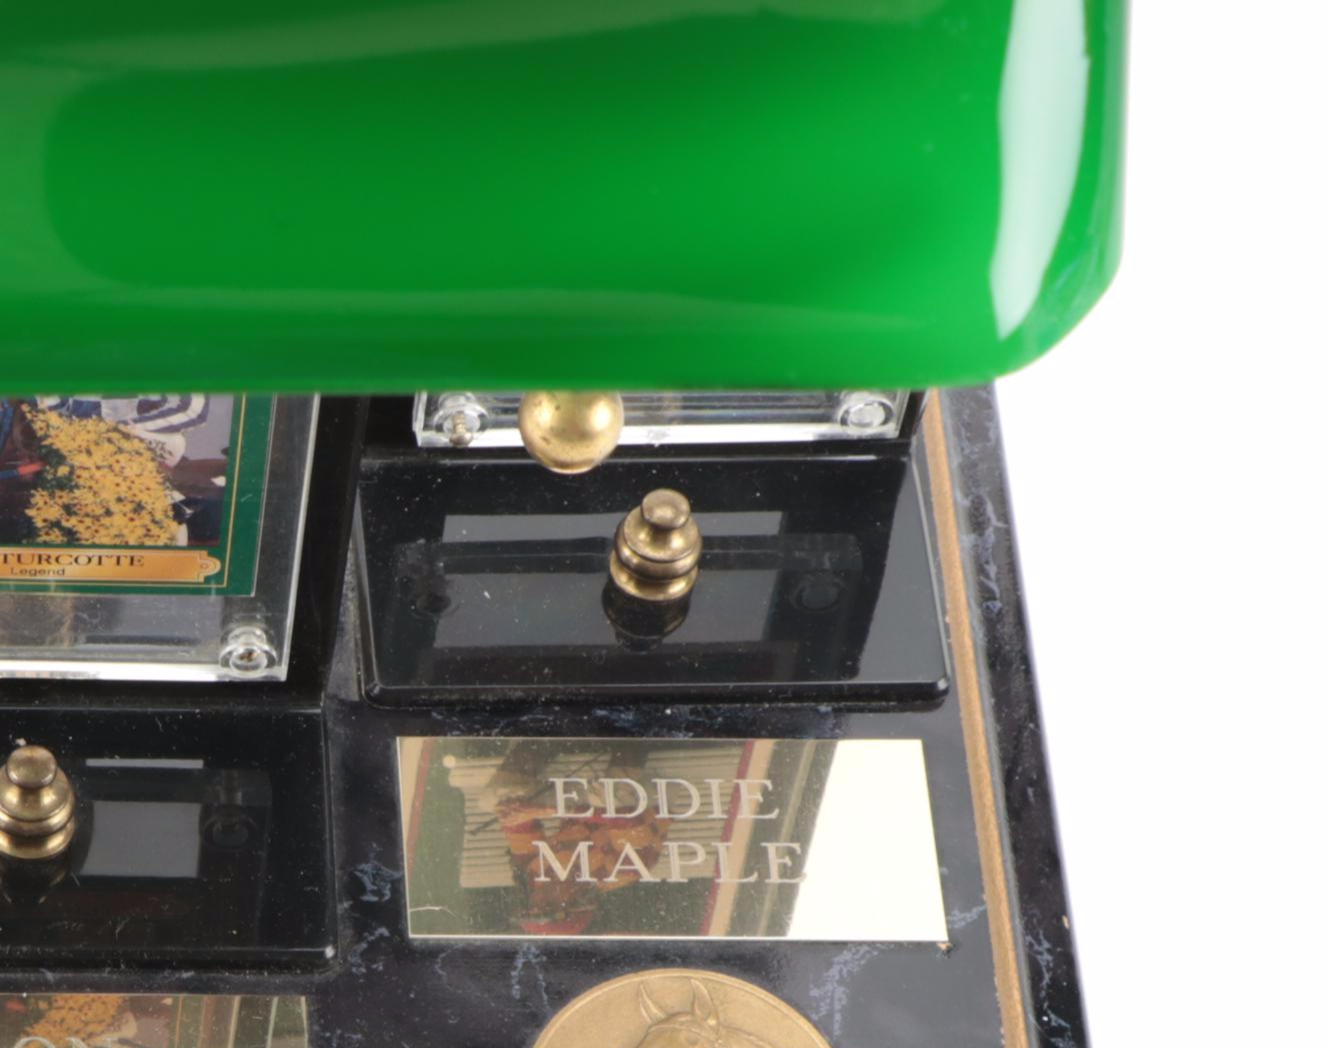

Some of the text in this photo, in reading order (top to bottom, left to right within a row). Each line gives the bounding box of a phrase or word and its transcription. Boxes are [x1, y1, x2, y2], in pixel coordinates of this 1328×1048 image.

[10, 567, 66, 577] Legend
[548, 777, 780, 820] EDDIE
[532, 840, 808, 884] MAPLE
